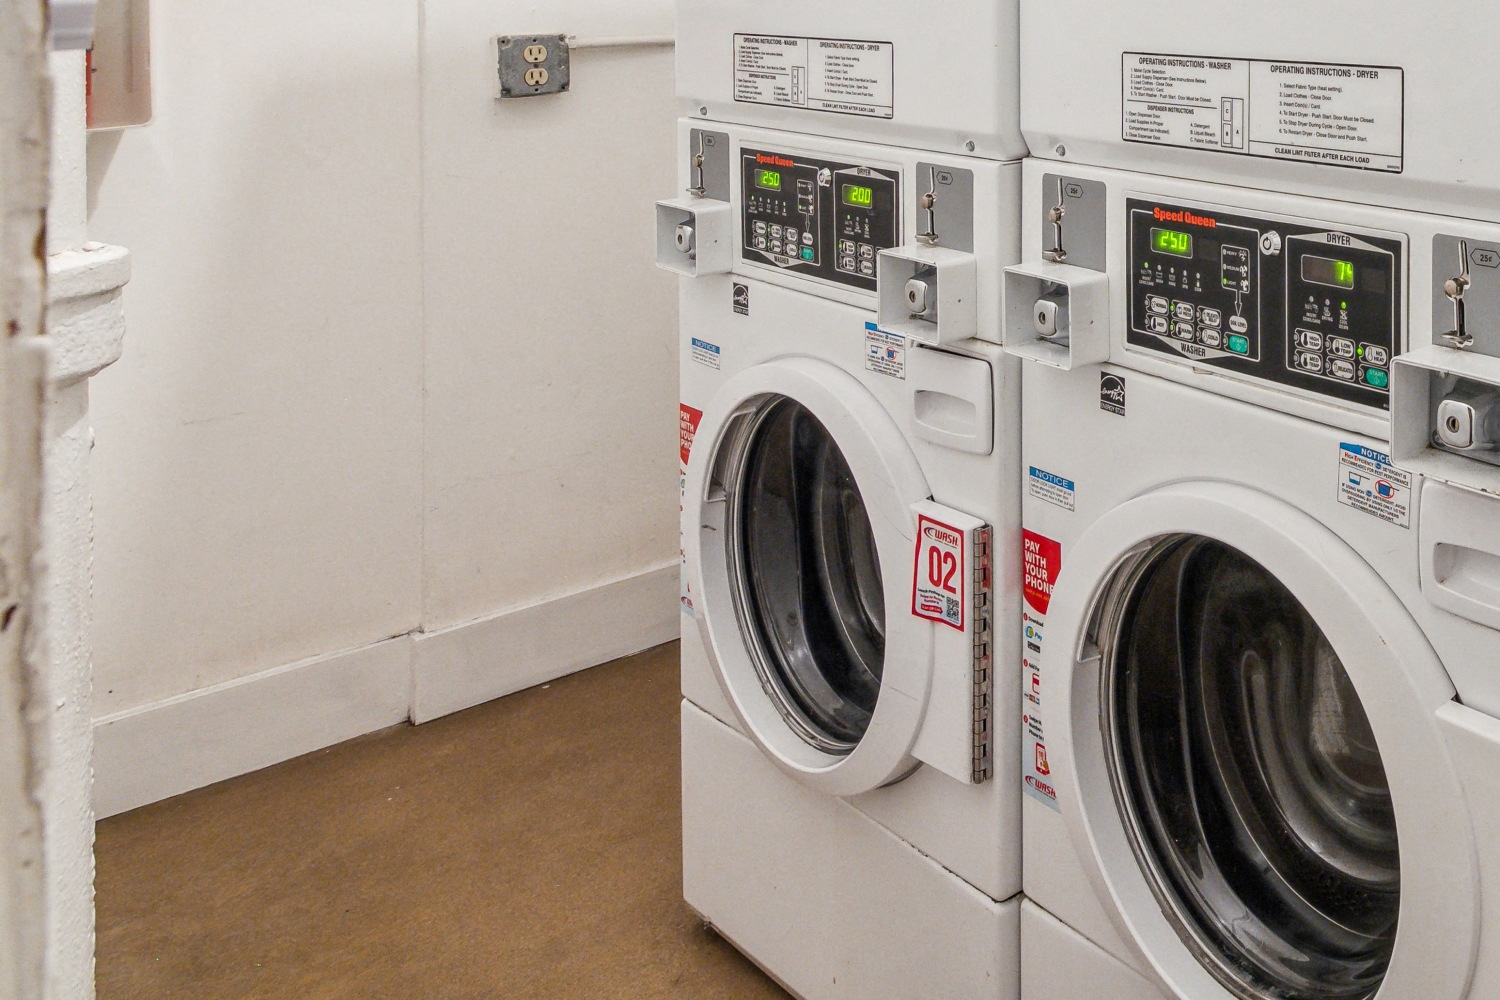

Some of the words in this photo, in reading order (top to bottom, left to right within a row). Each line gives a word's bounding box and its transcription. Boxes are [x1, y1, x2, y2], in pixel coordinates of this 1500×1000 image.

[756, 153, 774, 164] Speed
[775, 156, 794, 167] Queen
[762, 171, 780, 186] 250
[857, 167, 871, 176] DRYER
[852, 187, 871, 203] 200
[1154, 207, 1183, 222] Speed
[1184, 212, 1216, 228] Queen
[1160, 231, 1188, 250] 250
[1326, 233, 1350, 246] DRYER
[1480, 254, 1492, 262] 25¢
[695, 340, 717, 353] NOTICE
[1181, 343, 1206, 357] WASHER
[1361, 448, 1390, 464] NOTICE
[1035, 470, 1069, 488] NOTICE
[929, 545, 957, 595] 02
[1035, 780, 1056, 799] WASH
